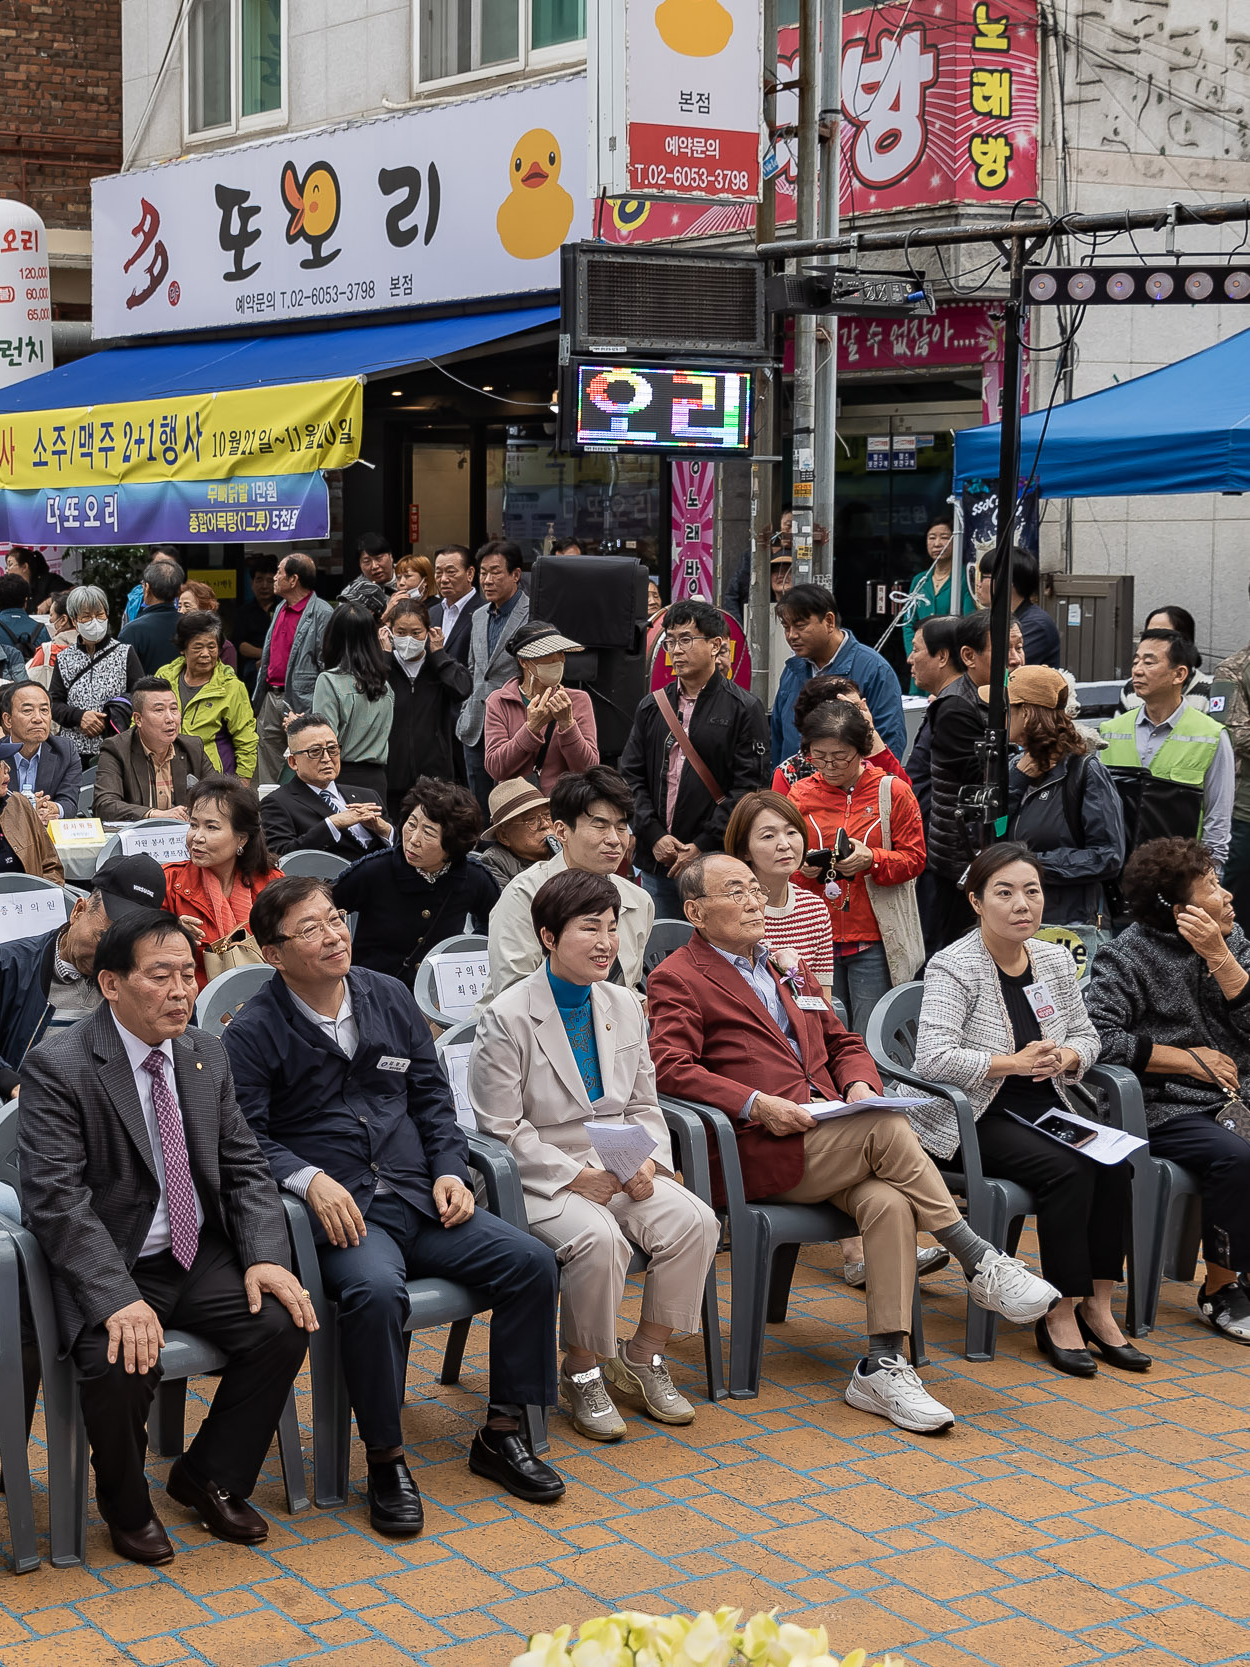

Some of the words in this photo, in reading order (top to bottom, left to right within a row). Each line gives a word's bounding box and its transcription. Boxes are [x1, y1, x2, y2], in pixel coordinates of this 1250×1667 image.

[679, 90, 710, 114] 본점
[971, 4, 1012, 188] 노래방
[665, 136, 720, 159] 예약문의
[635, 164, 749, 191] T.02-6053-3798
[19, 266, 48, 281] 120,000
[25, 287, 49, 302] 60,000
[235, 291, 277, 315] 예약문의
[280, 280, 376, 310] T.02-6053-3798
[388, 272, 414, 299] 본점
[27, 308, 50, 321] 65,000
[867, 321, 882, 357] 수
[579, 367, 740, 446] 오리
[32, 421, 116, 472] 소주/맥주
[122, 411, 203, 466] 2+1행사
[250, 480, 277, 503] 1만원
[45, 491, 119, 534] 다또오리
[189, 510, 270, 534] 종합어묵탕(1그릇)
[684, 487, 701, 594] 노래방
